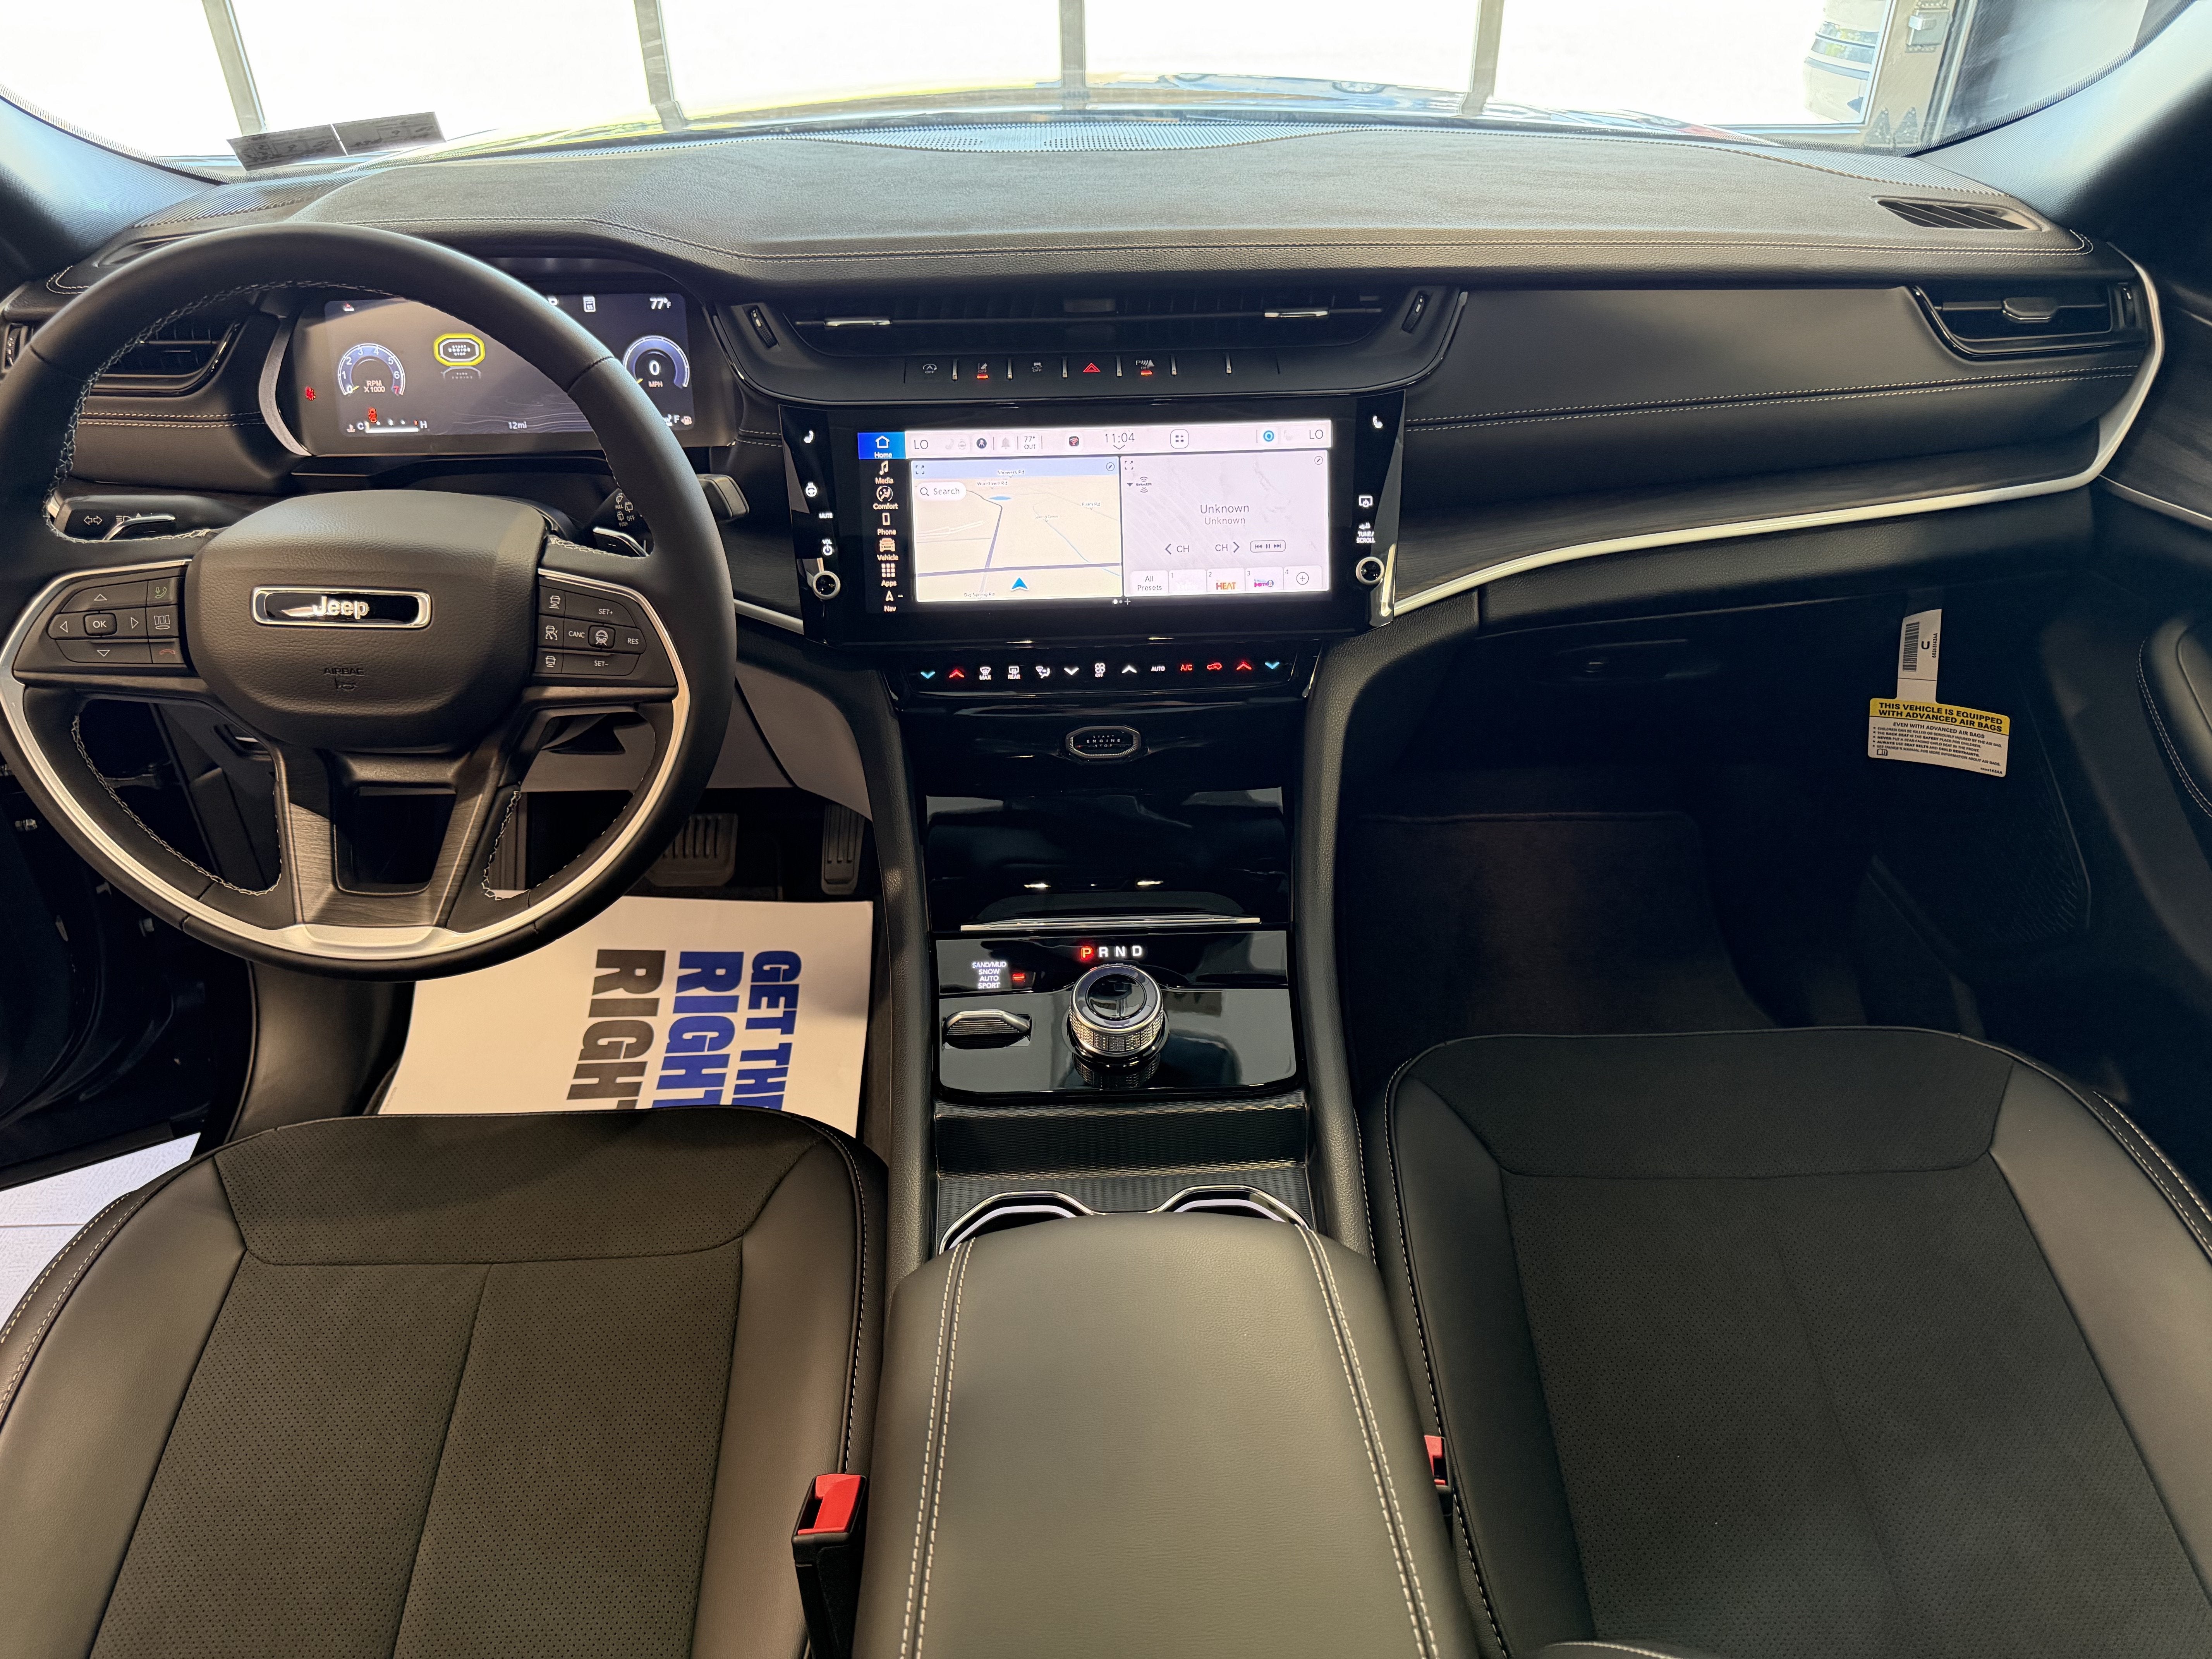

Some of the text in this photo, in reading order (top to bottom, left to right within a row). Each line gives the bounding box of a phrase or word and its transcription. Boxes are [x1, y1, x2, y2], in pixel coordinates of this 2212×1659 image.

[358, 347, 363, 356] 3
[346, 357, 352, 365] 2
[649, 360, 660, 375] 0
[347, 385, 353, 394] 0
[393, 386, 400, 395] 7
[673, 414, 680, 423] F
[420, 421, 428, 429] H
[508, 421, 527, 429] 12mi
[1104, 433, 1135, 443] 11:04
[1309, 430, 1323, 440] LO
[914, 440, 929, 450] LO
[1200, 504, 1249, 514] Unknown
[1216, 582, 1237, 590] HEAT
[312, 596, 370, 620] Jeep
[1921, 641, 1930, 649] U
[1903, 704, 1942, 714] VEHICLE
[1956, 710, 2003, 725] EQUIPPED
[1905, 712, 1957, 723] ADVANCED
[1977, 721, 2002, 732] BAGS
[1926, 725, 1958, 733] ADVANCED
[1083, 945, 1142, 958] P R N D
[745, 951, 802, 1035] GET
[567, 949, 666, 1109] RIGH
